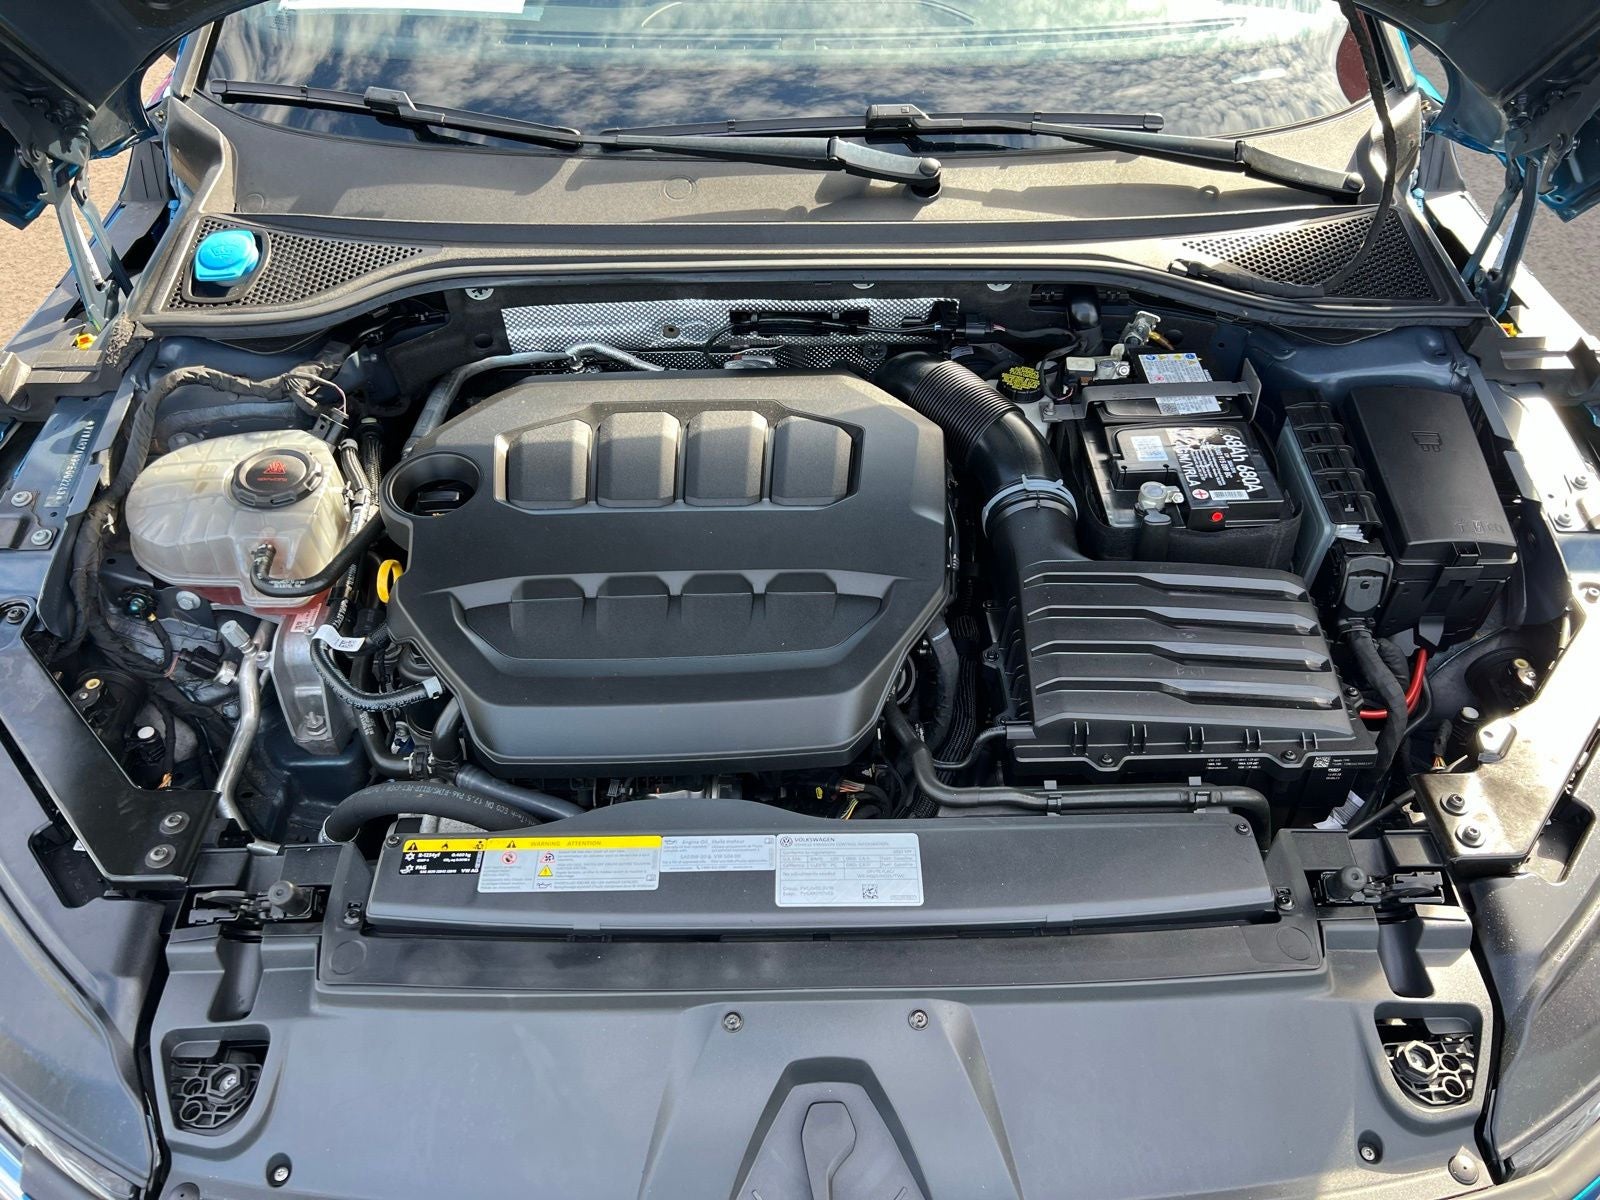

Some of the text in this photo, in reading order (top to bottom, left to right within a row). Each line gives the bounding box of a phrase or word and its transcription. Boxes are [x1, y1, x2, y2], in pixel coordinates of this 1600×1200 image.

[1222, 434, 1263, 493] 68Ah 680A
[466, 795, 482, 804] 17.5
[485, 801, 495, 809] DN
